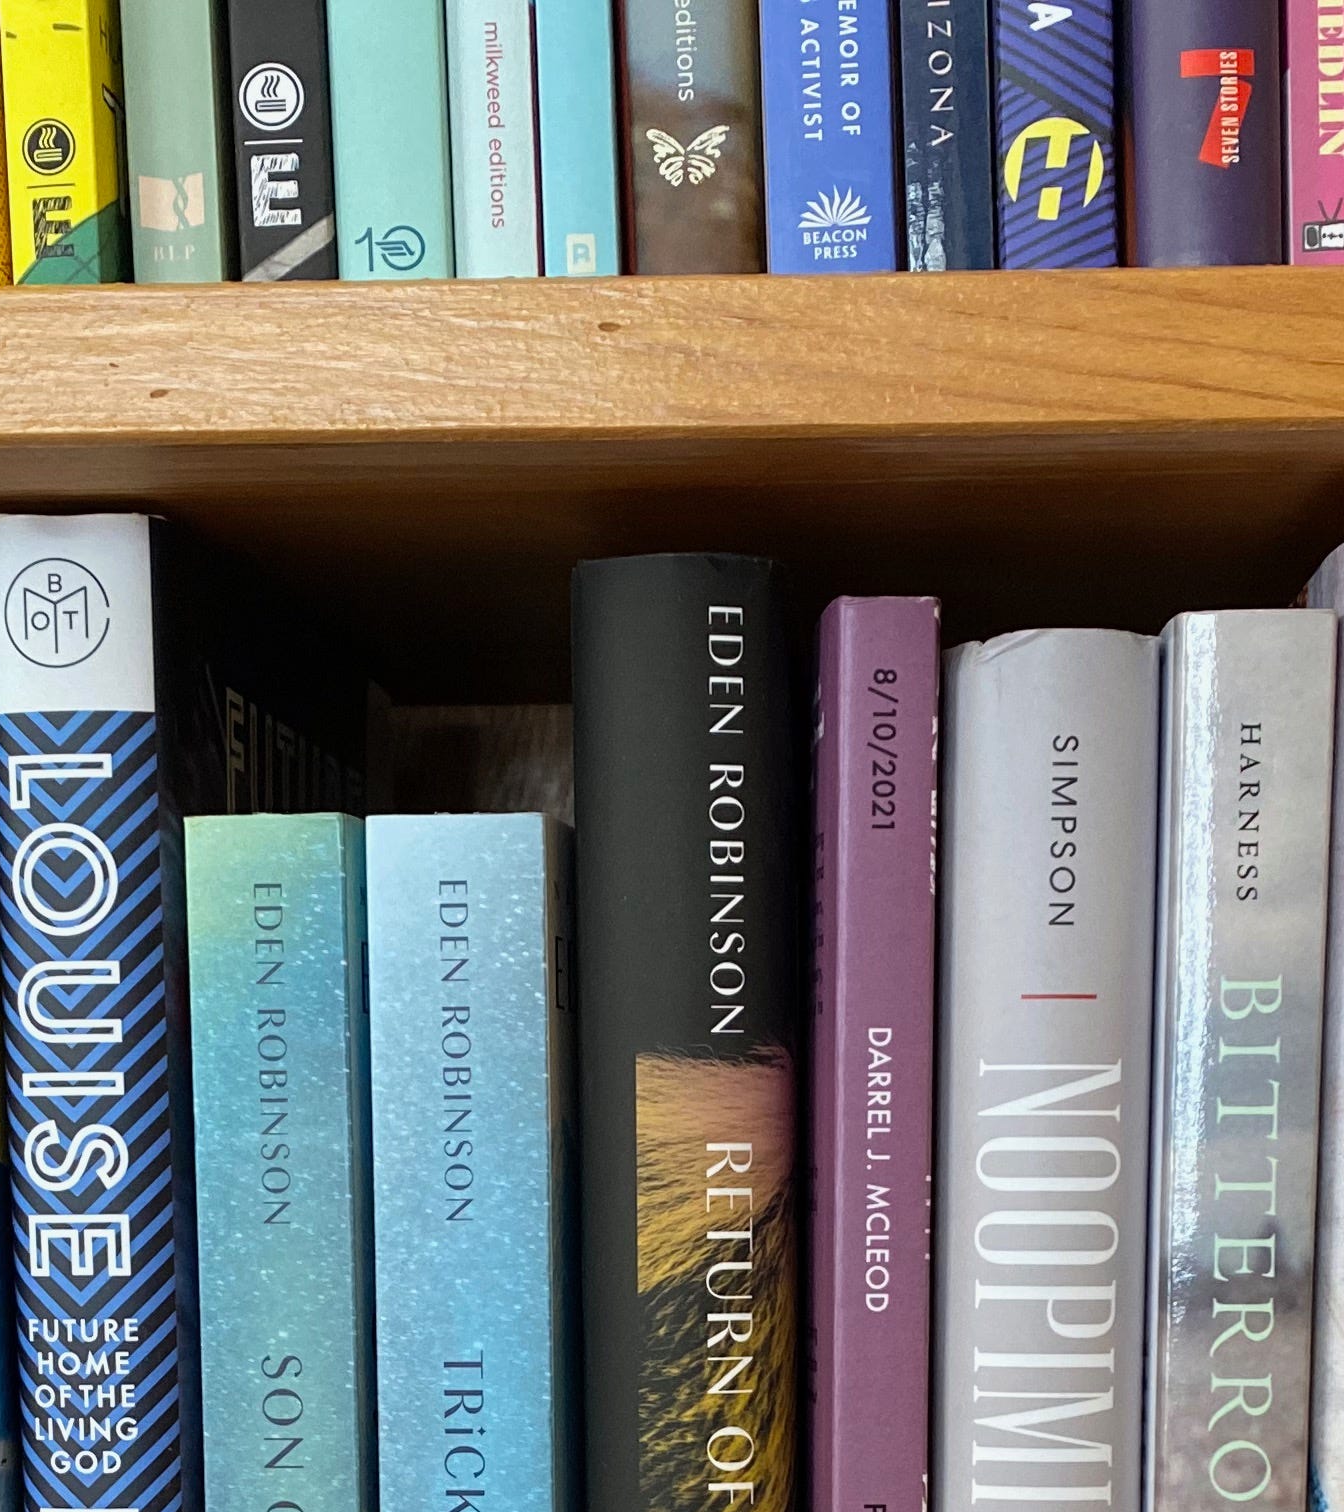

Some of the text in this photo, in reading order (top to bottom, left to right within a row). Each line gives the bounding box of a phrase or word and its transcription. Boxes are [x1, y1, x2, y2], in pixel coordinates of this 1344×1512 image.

[484, 21, 507, 229] milkweed editions
[800, 18, 823, 142] ACTIVIST
[841, 101, 862, 137] OF
[1219, 50, 1240, 164] SEVEN STORIES
[802, 227, 868, 245] BEACON
[813, 244, 858, 261] PRESS
[867, 667, 897, 831] 8/10/2021
[708, 605, 747, 1034] EDEN ROBINSON
[1048, 735, 1079, 928] SIMPSON
[1236, 722, 1262, 902] HARNESS
[7, 753, 132, 1277] LOUISE
[253, 882, 291, 1225] EDEN ROBINSON
[438, 879, 474, 1222] EDEN ROBINSON
[866, 1027, 893, 1139] DARREL
[865, 1150, 890, 1170] J.
[705, 1142, 754, 1396] RETURN
[864, 1183, 890, 1313] MCLEOD
[29, 1318, 140, 1343] FUTURE
[37, 1351, 130, 1376] HOME
[34, 1384, 137, 1409] OF THE
[34, 1417, 139, 1442] LIVING
[260, 1354, 306, 1470] SON
[50, 1450, 122, 1475] GOD
[706, 1426, 755, 1505] OF
